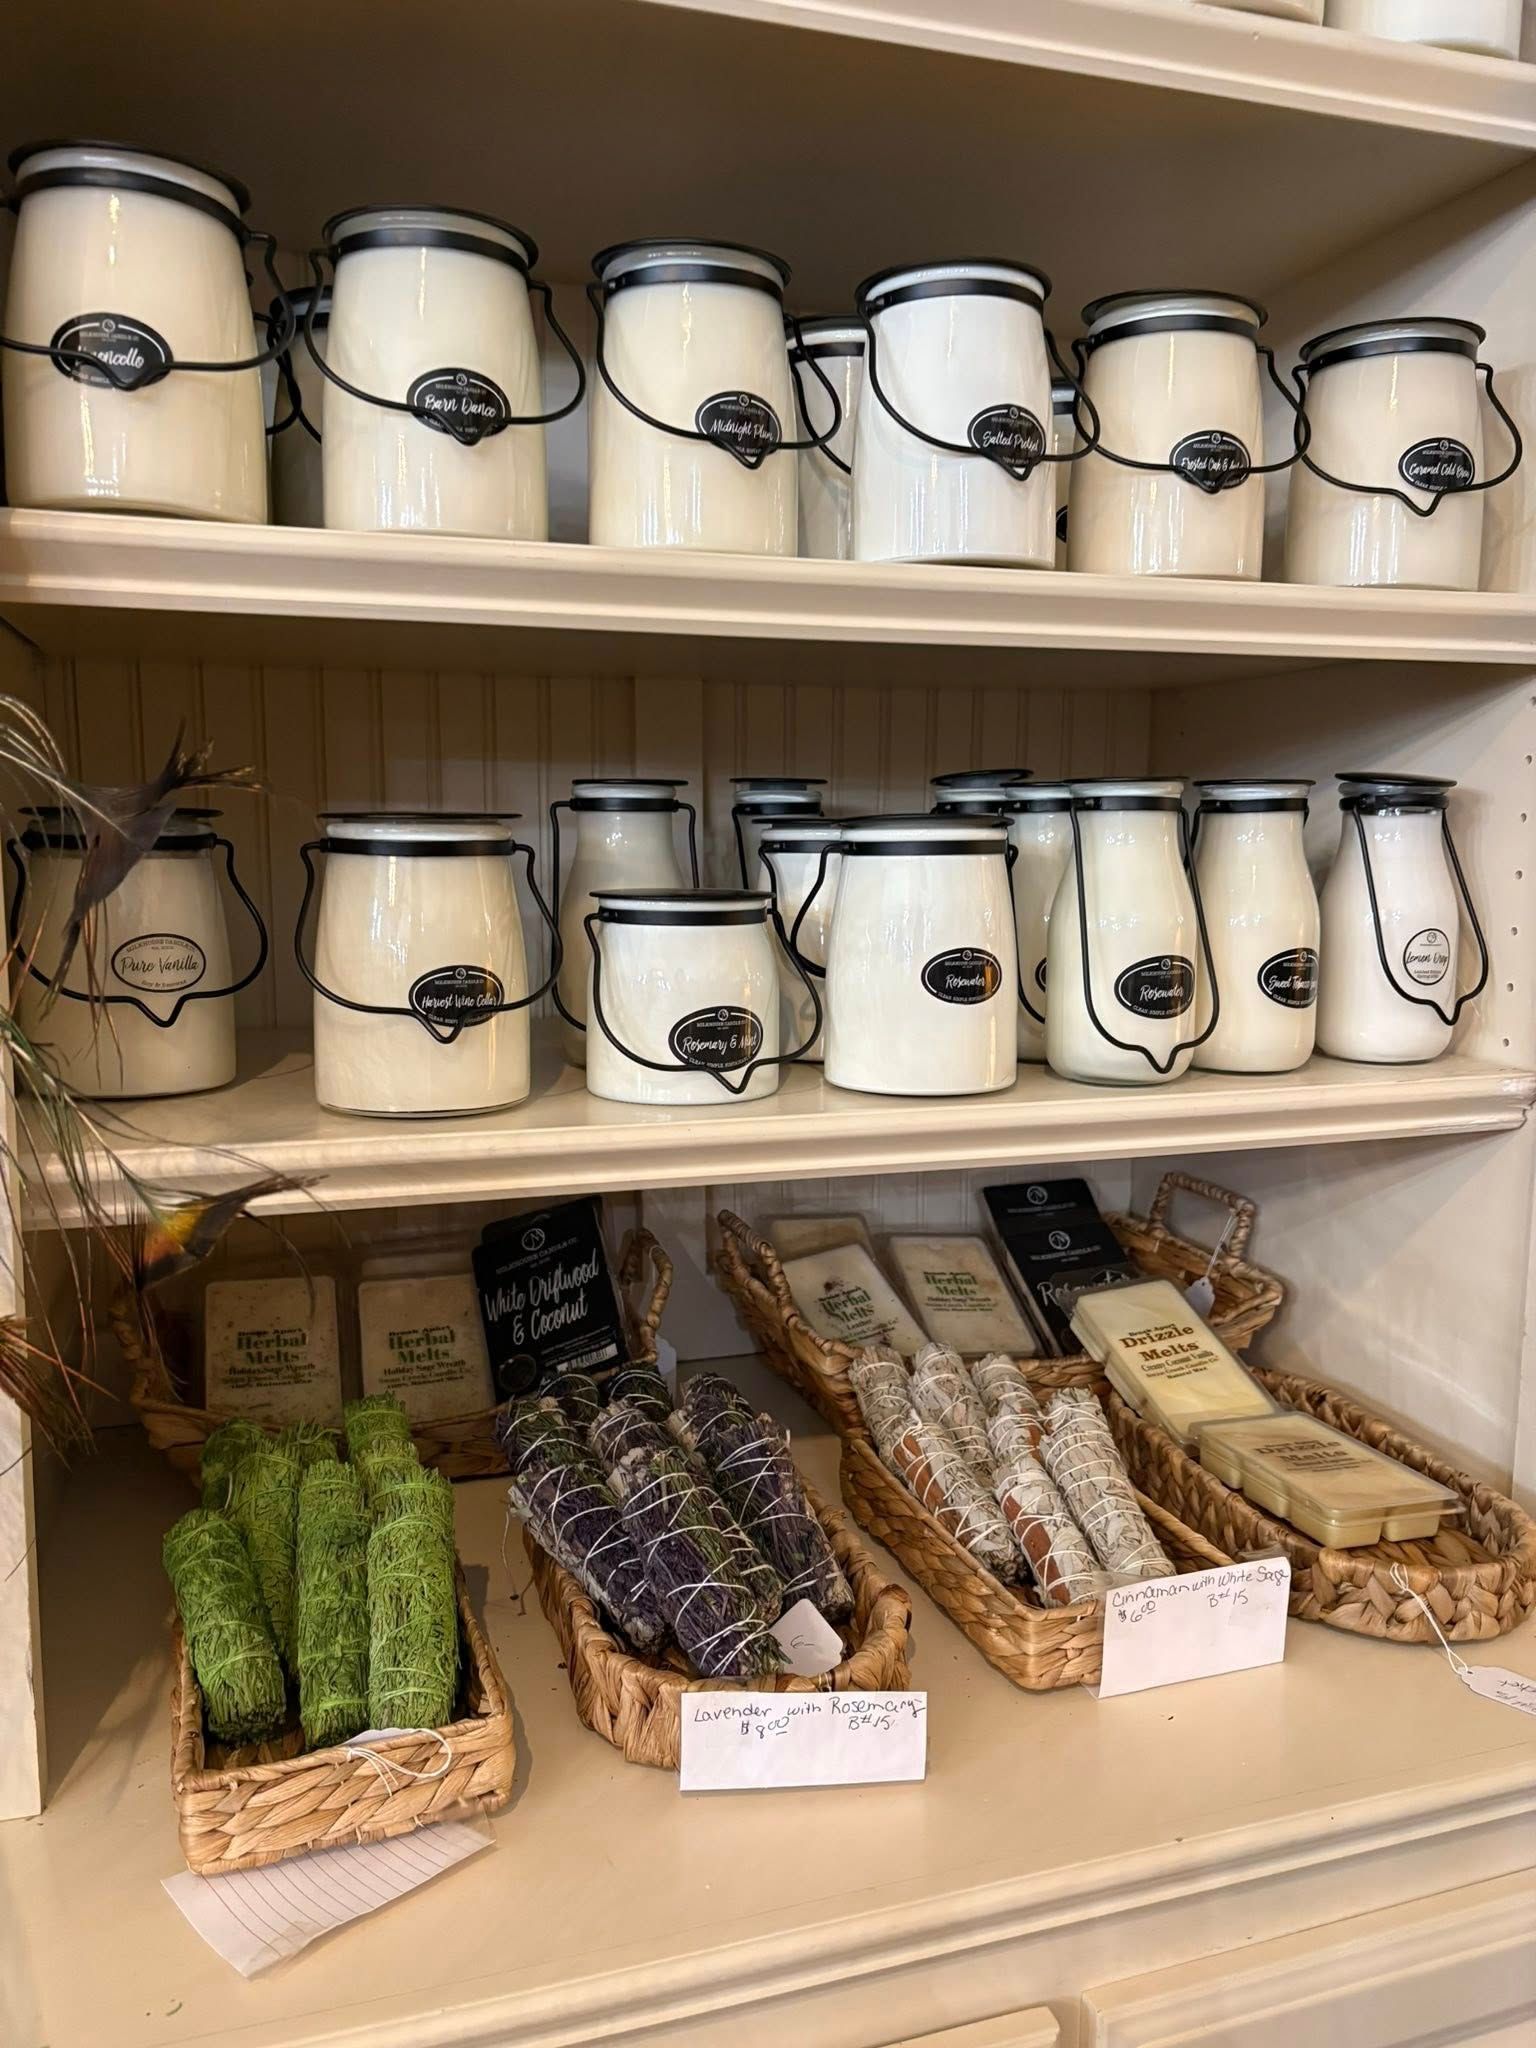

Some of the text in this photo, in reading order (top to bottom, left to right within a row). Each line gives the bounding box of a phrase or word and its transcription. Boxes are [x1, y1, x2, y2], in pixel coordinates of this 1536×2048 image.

[425, 394, 457, 412] Barn
[710, 419, 752, 442] Midnight
[983, 431, 1013, 448] Salted
[121, 955, 198, 975] Pure Vanilla
[1406, 951, 1431, 964] Lemon
[422, 994, 453, 1009] Harvest
[1139, 984, 1184, 1002] Rosewater
[682, 1036, 728, 1055] Rosemary
[729, 1034, 738, 1049] &
[485, 1247, 600, 1321] White Driftwood
[924, 1274, 979, 1286] Herbal
[935, 1285, 977, 1296] Melts
[820, 1289, 872, 1313] Herbal
[513, 1288, 588, 1346] & Coconut
[236, 1332, 307, 1350] Herbal
[389, 1328, 456, 1350] Herbal
[1119, 1326, 1195, 1349] Drizzle
[245, 1350, 300, 1365] Melts
[398, 1347, 451, 1364] Melts
[1138, 1342, 1199, 1362] Melts
[1192, 1575, 1215, 1593] with
[1217, 1571, 1253, 1588] White
[1256, 1566, 1289, 1587] Sage
[694, 1696, 926, 1722] Lavender with Rosemary
